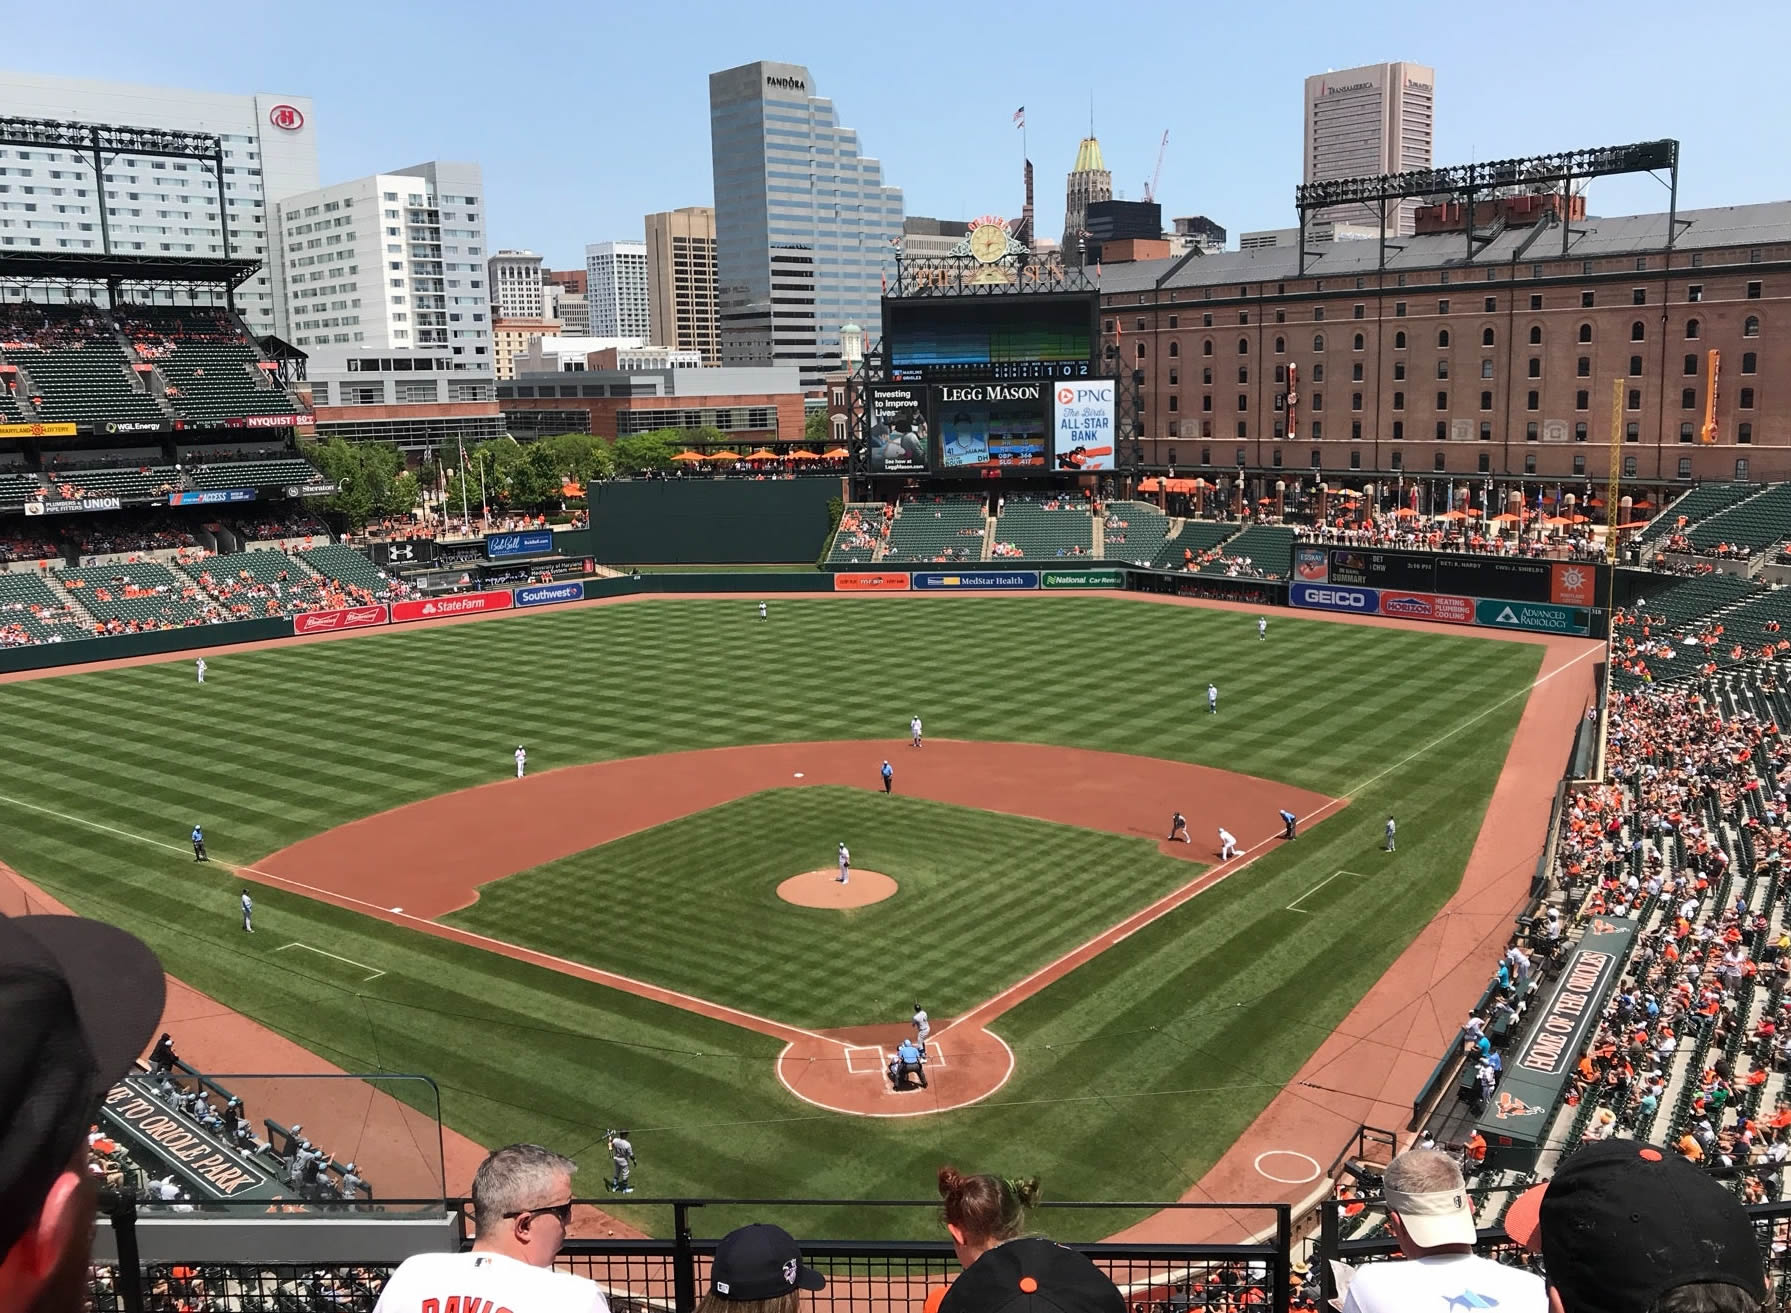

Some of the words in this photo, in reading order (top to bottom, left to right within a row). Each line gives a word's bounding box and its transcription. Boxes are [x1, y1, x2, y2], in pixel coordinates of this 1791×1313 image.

[767, 76, 805, 91] PANDORA
[1023, 265, 1065, 284] SUN
[1063, 366, 1071, 376] 0
[1080, 365, 1088, 375] 2
[874, 390, 911, 399] Investing
[943, 387, 982, 401] LEGG
[986, 386, 1040, 400] MASON
[1077, 389, 1112, 402] PNC
[885, 399, 918, 408] Improve
[1064, 408, 1080, 417] The
[135, 422, 160, 431] Energy
[248, 416, 291, 426] NYQUIST
[1061, 418, 1109, 430] ALL-STAR
[1071, 430, 1098, 441] BANK
[302, 484, 335, 492] Sheraton
[202, 492, 227, 501] ACCESS
[83, 497, 120, 509] UNION
[962, 576, 994, 585] MedStar
[996, 576, 1024, 585] Health
[1055, 576, 1087, 584] National
[1332, 573, 1367, 584] SUMMARY
[522, 586, 571, 602] Southwest
[1305, 589, 1365, 607] GEICO
[1435, 597, 1465, 607] HEATING
[1386, 602, 1432, 614] HORIZON
[1435, 605, 1470, 614] PLUMBING
[1522, 607, 1566, 620] ADVANCED
[1435, 612, 1465, 620] COOLING
[1520, 615, 1568, 629] RADIOLOGY
[1566, 951, 1608, 993] ORIOLES
[1553, 991, 1588, 1016] THE
[1545, 1013, 1575, 1033] OF
[1523, 1032, 1568, 1072] HOME
[116, 1098, 154, 1118] TO
[138, 1115, 211, 1162] ORIOLE
[190, 1153, 256, 1194] PARK
